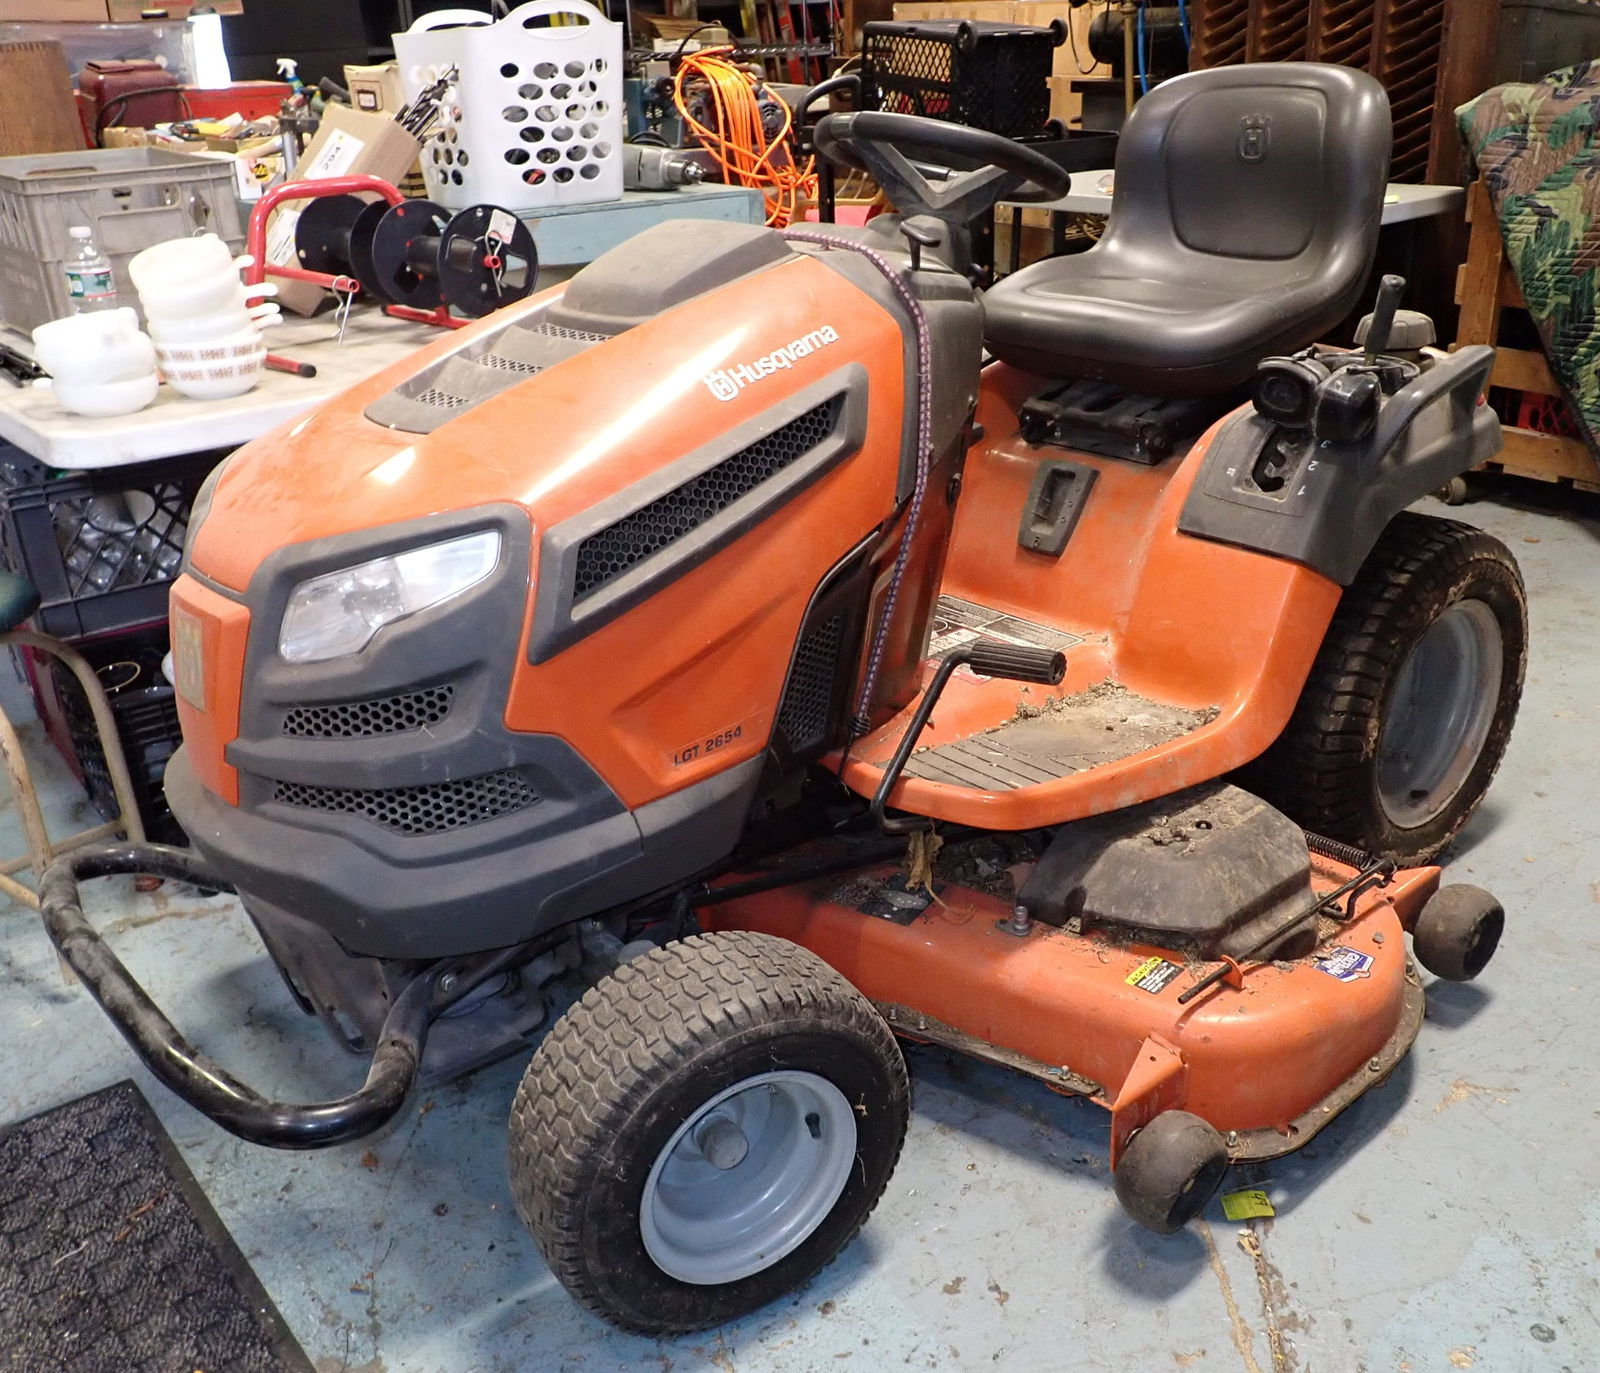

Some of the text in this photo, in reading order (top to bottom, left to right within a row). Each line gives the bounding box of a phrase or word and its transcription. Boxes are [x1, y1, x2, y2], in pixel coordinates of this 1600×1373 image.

[728, 325, 839, 388] Husqvarna
[1308, 460, 1319, 471] 2
[1297, 485, 1306, 496] 1
[674, 726, 742, 767] LGT 2654
